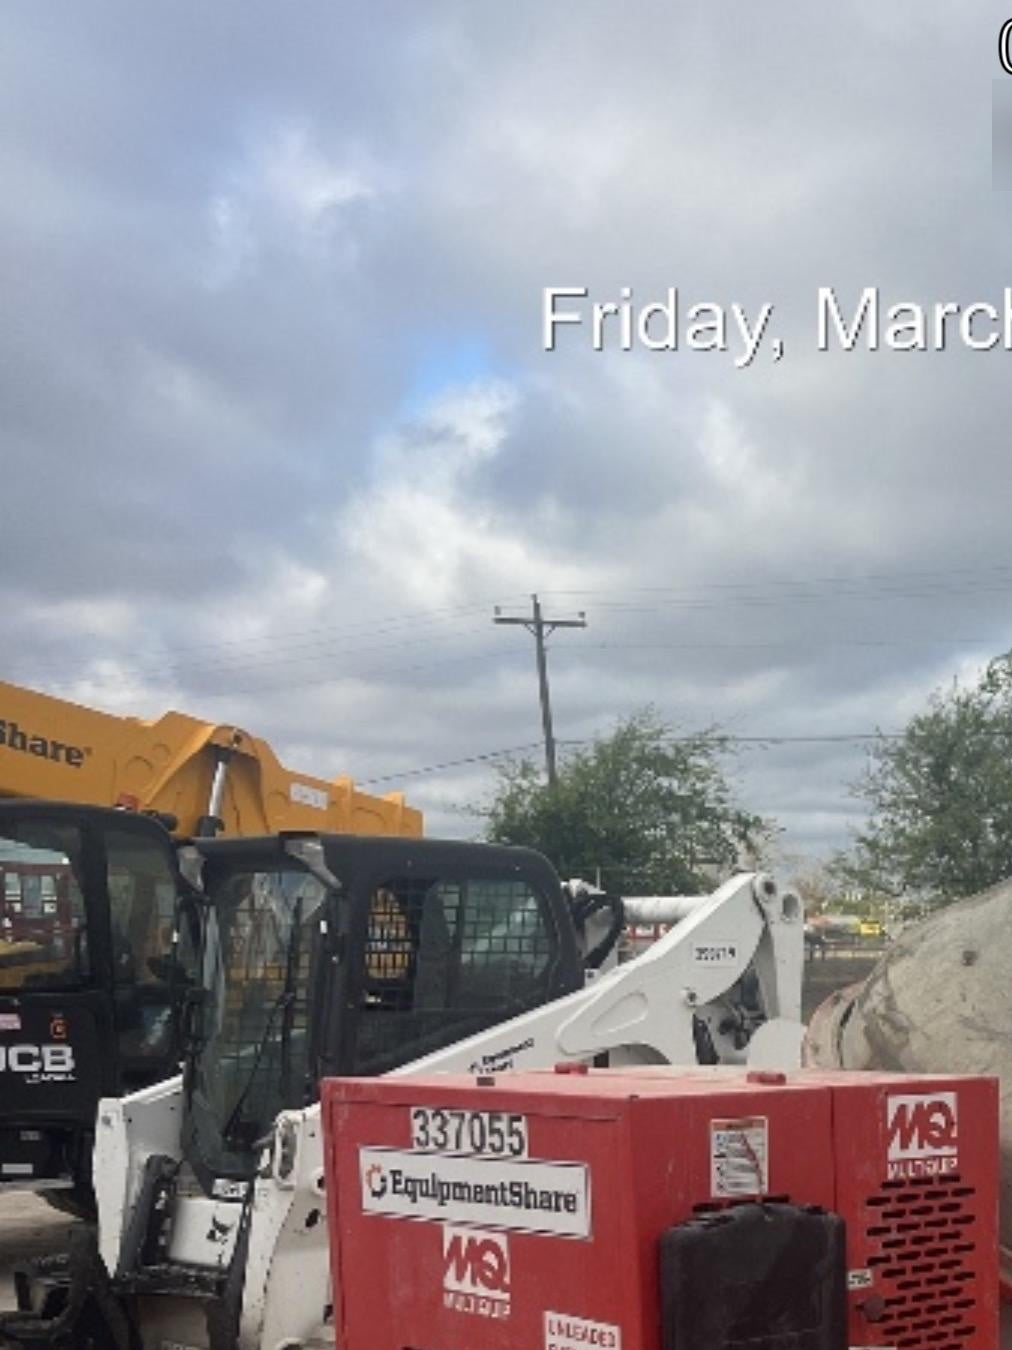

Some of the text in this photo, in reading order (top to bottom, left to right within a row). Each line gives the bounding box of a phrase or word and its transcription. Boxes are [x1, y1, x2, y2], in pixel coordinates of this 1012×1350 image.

[0, 1045, 75, 1072] CB
[413, 1109, 525, 1156] 337055
[389, 1169, 578, 1214] EquipmentShare
